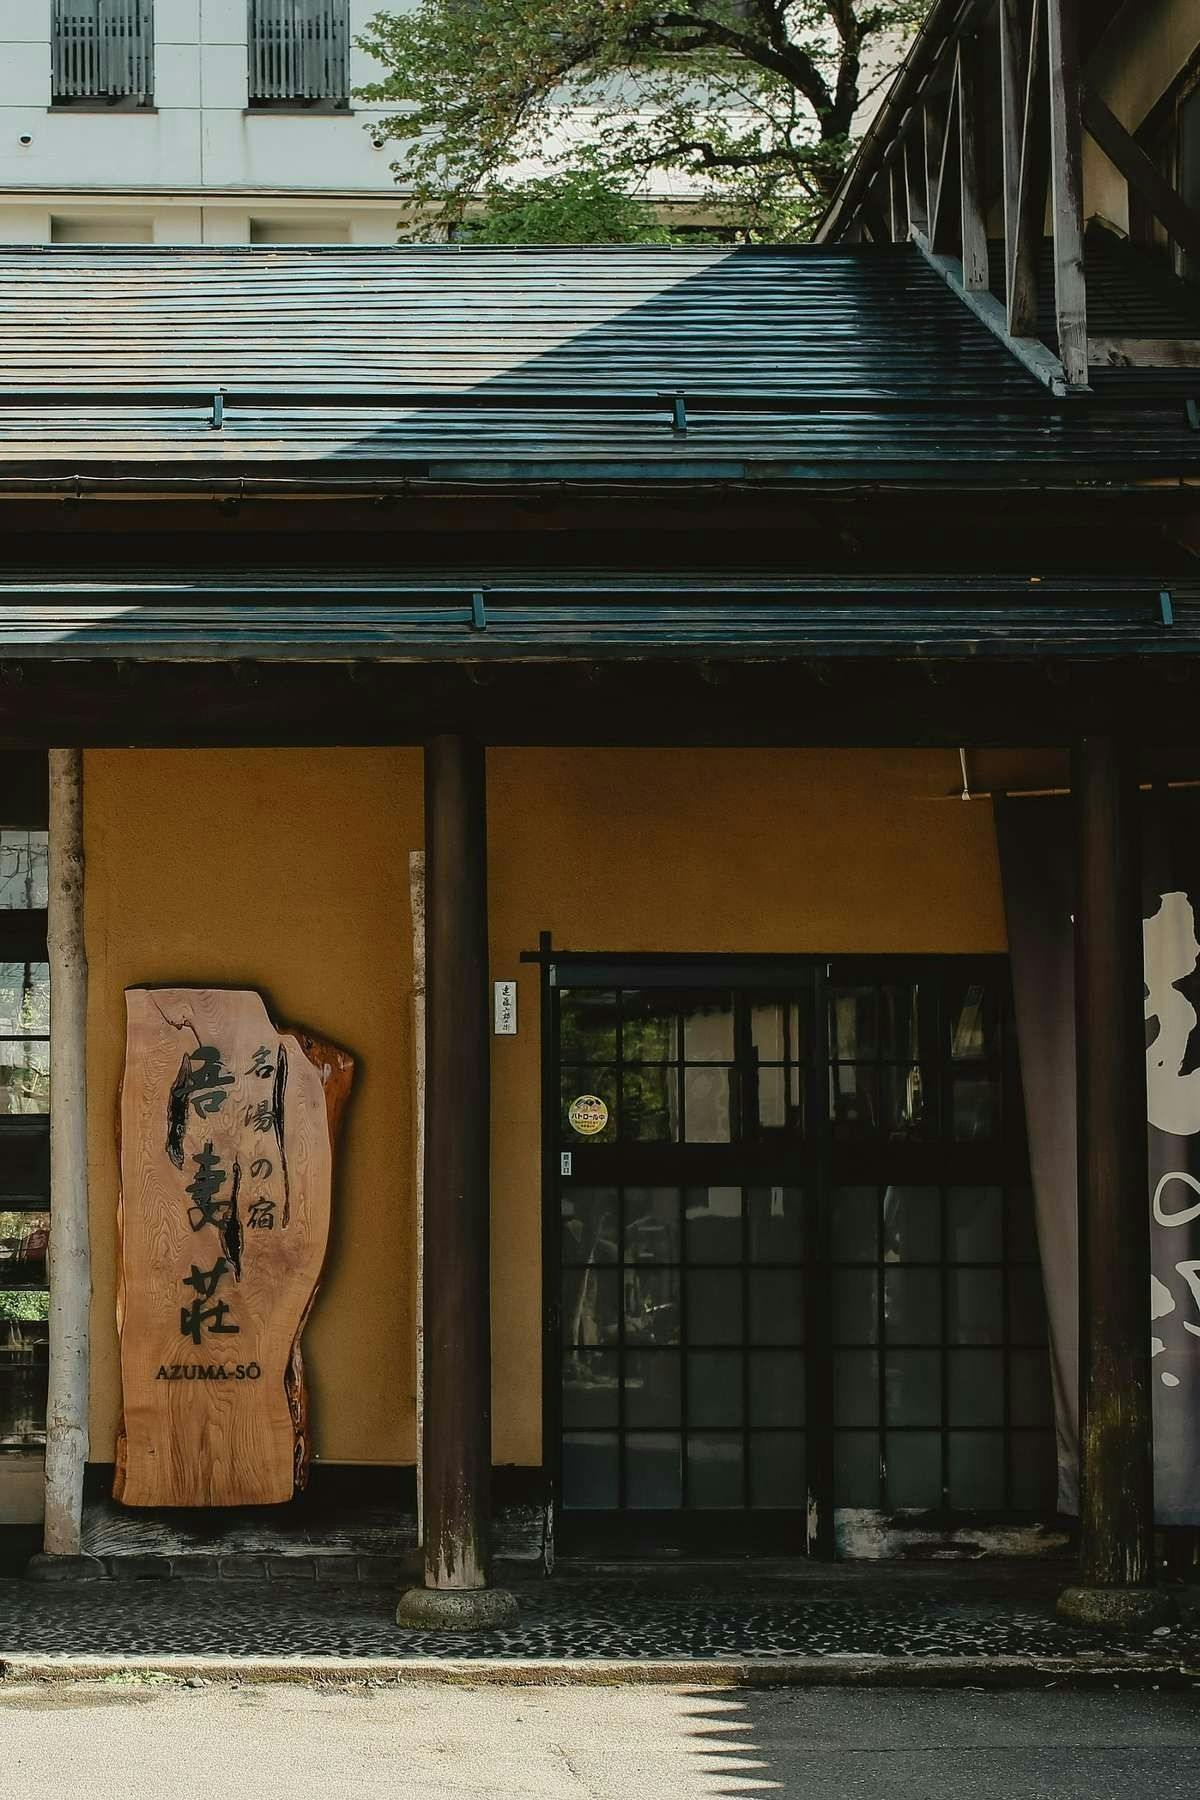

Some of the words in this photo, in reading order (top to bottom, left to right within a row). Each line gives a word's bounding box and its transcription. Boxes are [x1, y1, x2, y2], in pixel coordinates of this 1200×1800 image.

[175, 1046, 240, 1345] 吾妻荘
[245, 1046, 276, 1231] 名湯の宿
